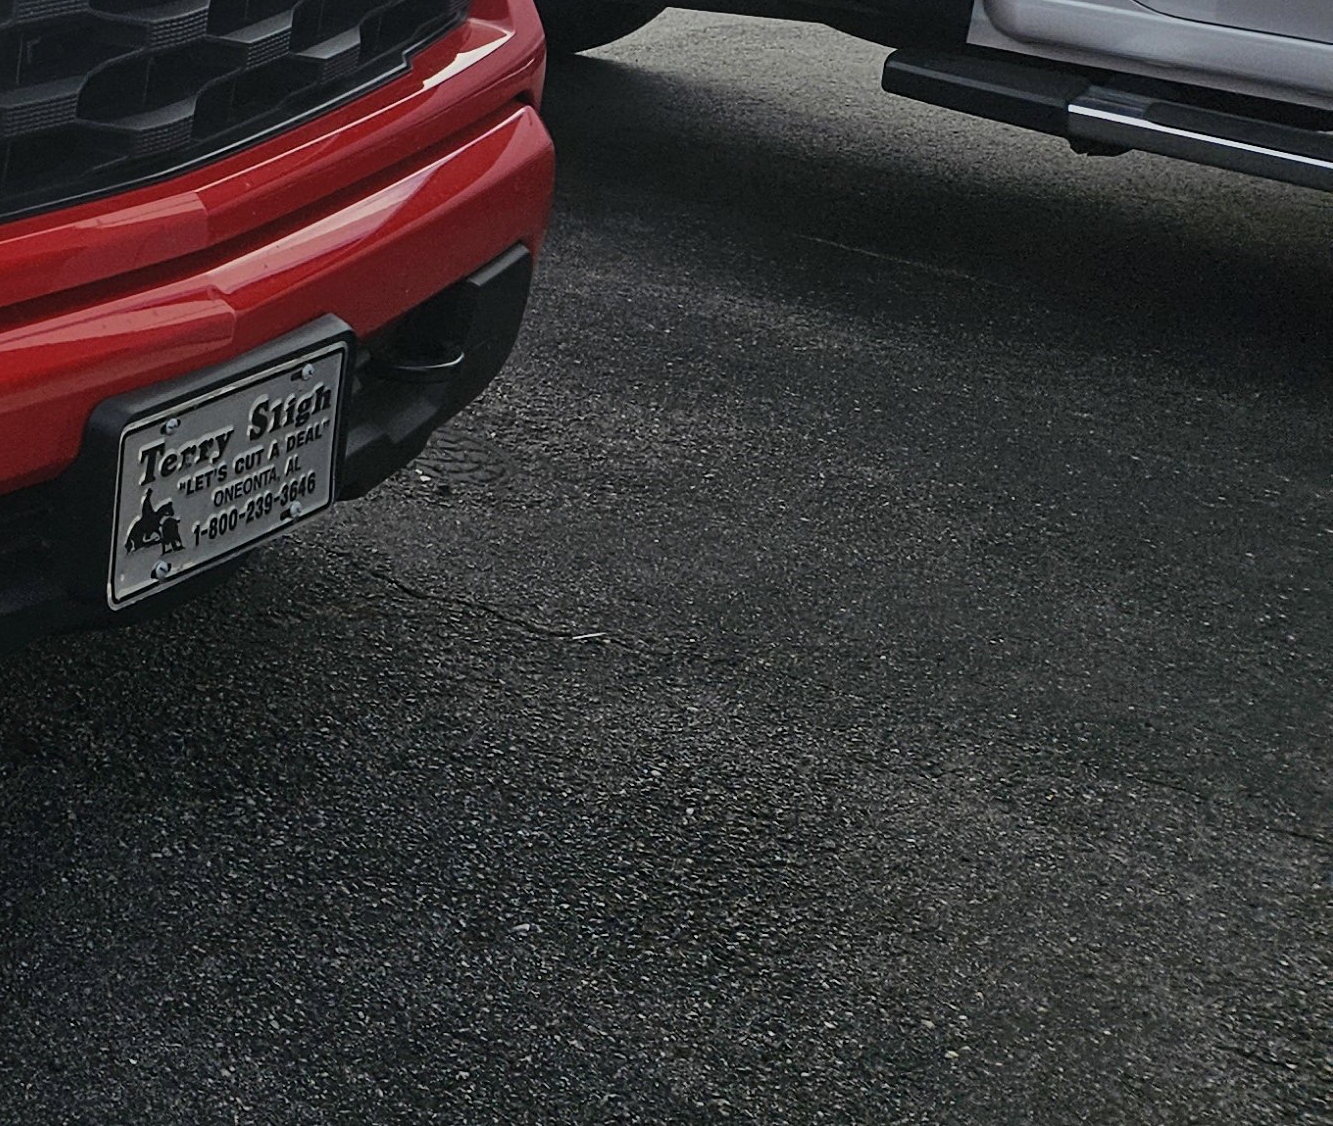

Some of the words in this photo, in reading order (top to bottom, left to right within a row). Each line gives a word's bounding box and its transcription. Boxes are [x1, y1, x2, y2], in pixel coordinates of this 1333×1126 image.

[139, 425, 235, 486] Terry
[234, 445, 265, 474] CUT
[268, 439, 280, 461] A
[285, 418, 331, 453] DEAL"
[193, 469, 316, 547] 1-800-239-3646
[213, 464, 281, 508] ONEONTA,
[285, 453, 302, 476] AL
